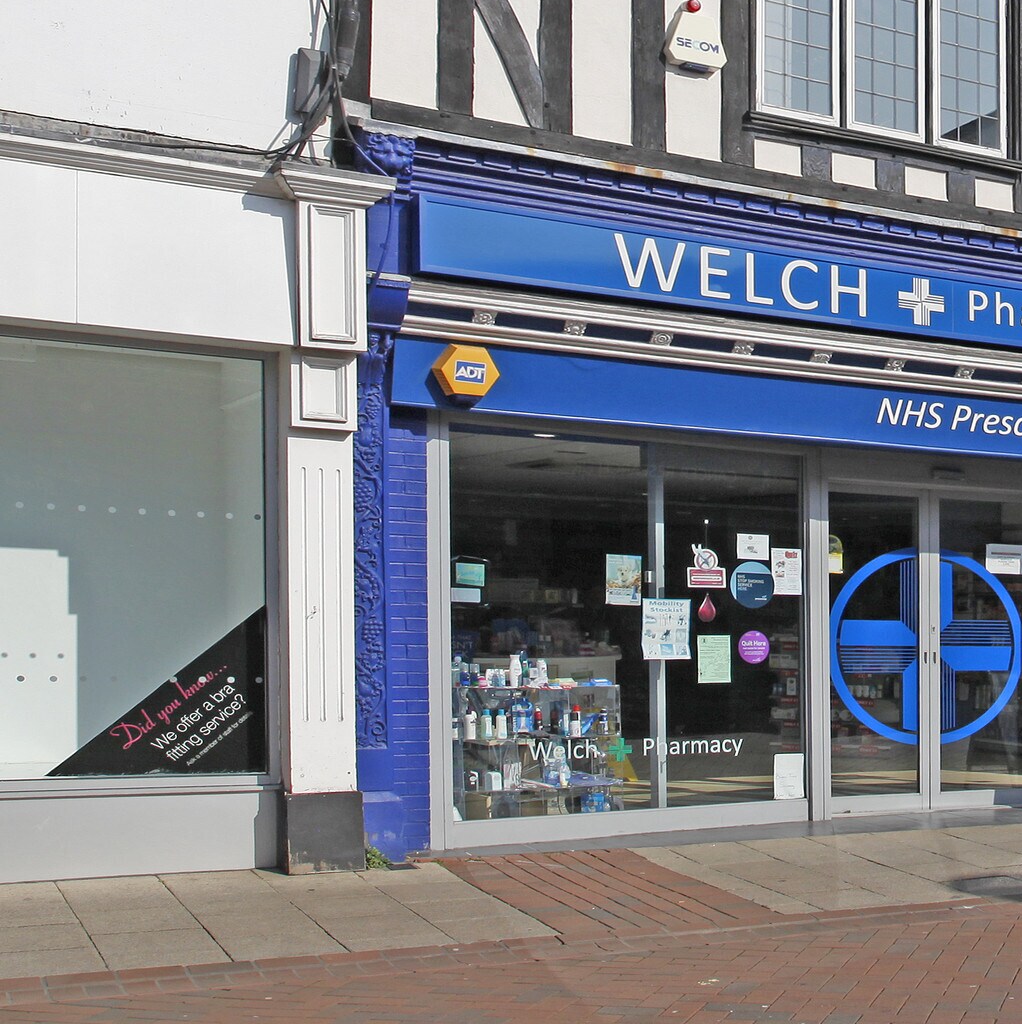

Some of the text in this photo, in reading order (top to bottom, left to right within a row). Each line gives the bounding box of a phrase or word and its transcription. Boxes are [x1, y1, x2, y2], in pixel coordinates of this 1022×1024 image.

[676, 36, 719, 54] SECOM
[613, 233, 867, 317] WELCH
[455, 366, 486, 379] ADT
[876, 397, 945, 429] NHS
[110, 709, 156, 750] Did
[157, 699, 181, 725] you
[150, 684, 236, 750] We offer a bra
[166, 693, 247, 762] fitting service?
[528, 737, 744, 760] Welch Pharmacy
